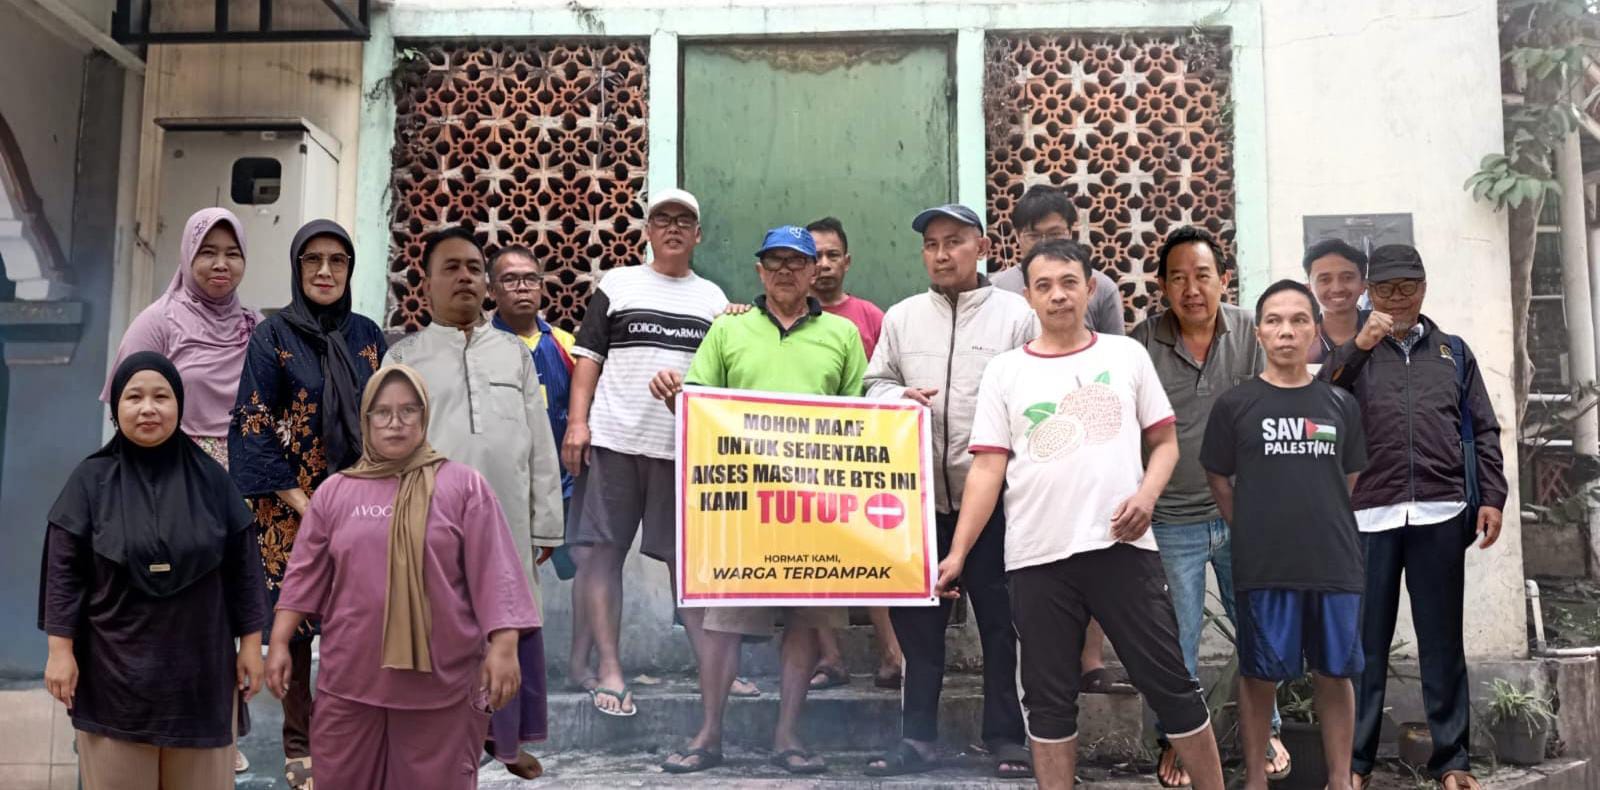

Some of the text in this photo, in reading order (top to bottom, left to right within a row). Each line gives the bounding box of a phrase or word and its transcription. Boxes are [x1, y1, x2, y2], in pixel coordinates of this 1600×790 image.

[628, 323, 662, 334] GIORGIO
[744, 413, 865, 437] MOHON MAAF
[717, 437, 890, 463] UNTUK SEMENTARA
[692, 464, 916, 490] AKSES MASUK KE BTS INI
[351, 504, 393, 517] AVOC
[700, 490, 859, 524] KAMI TUTUP
[764, 554, 841, 564] HORMAT KAMI,
[713, 566, 892, 580] WARGA TERDAMPAK
